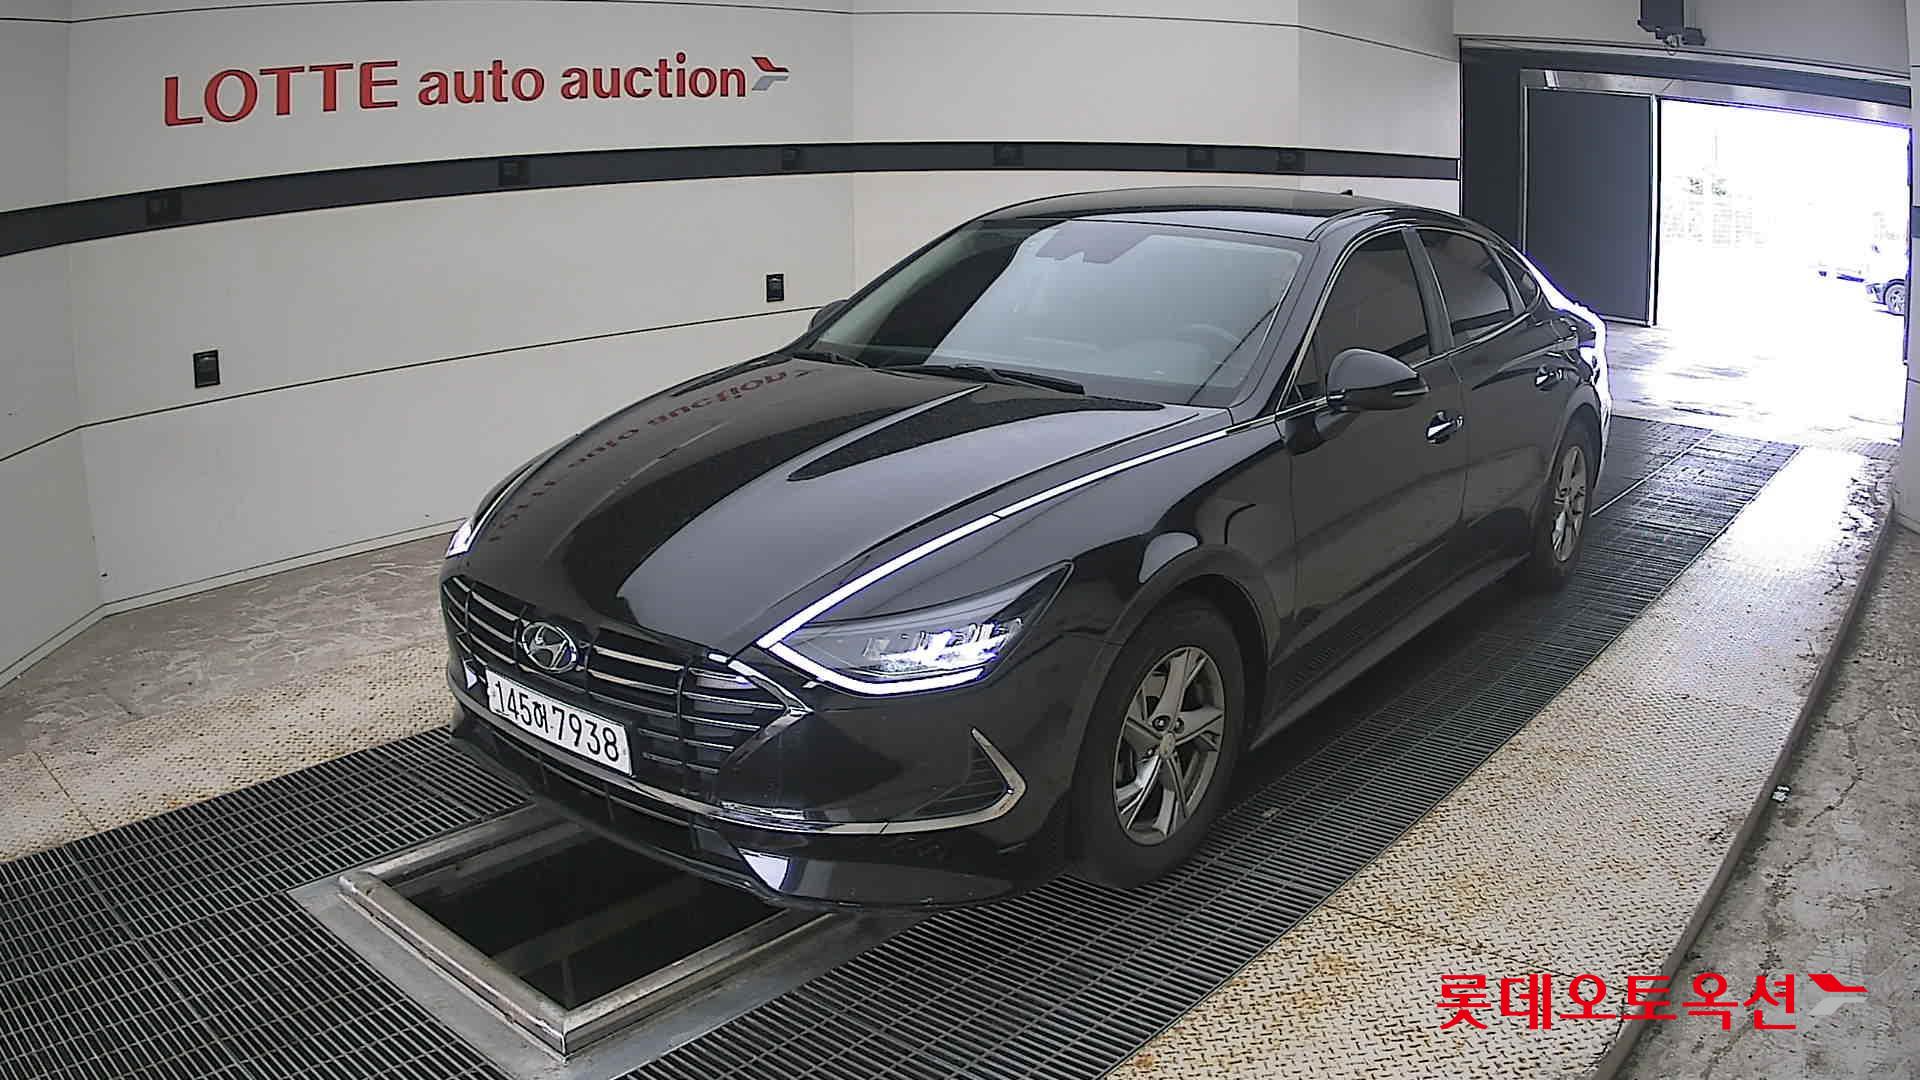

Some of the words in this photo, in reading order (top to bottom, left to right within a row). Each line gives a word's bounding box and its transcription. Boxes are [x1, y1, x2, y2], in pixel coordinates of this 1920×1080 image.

[164, 60, 399, 127] LOTTE
[417, 60, 545, 106] auto
[560, 52, 746, 100] auction
